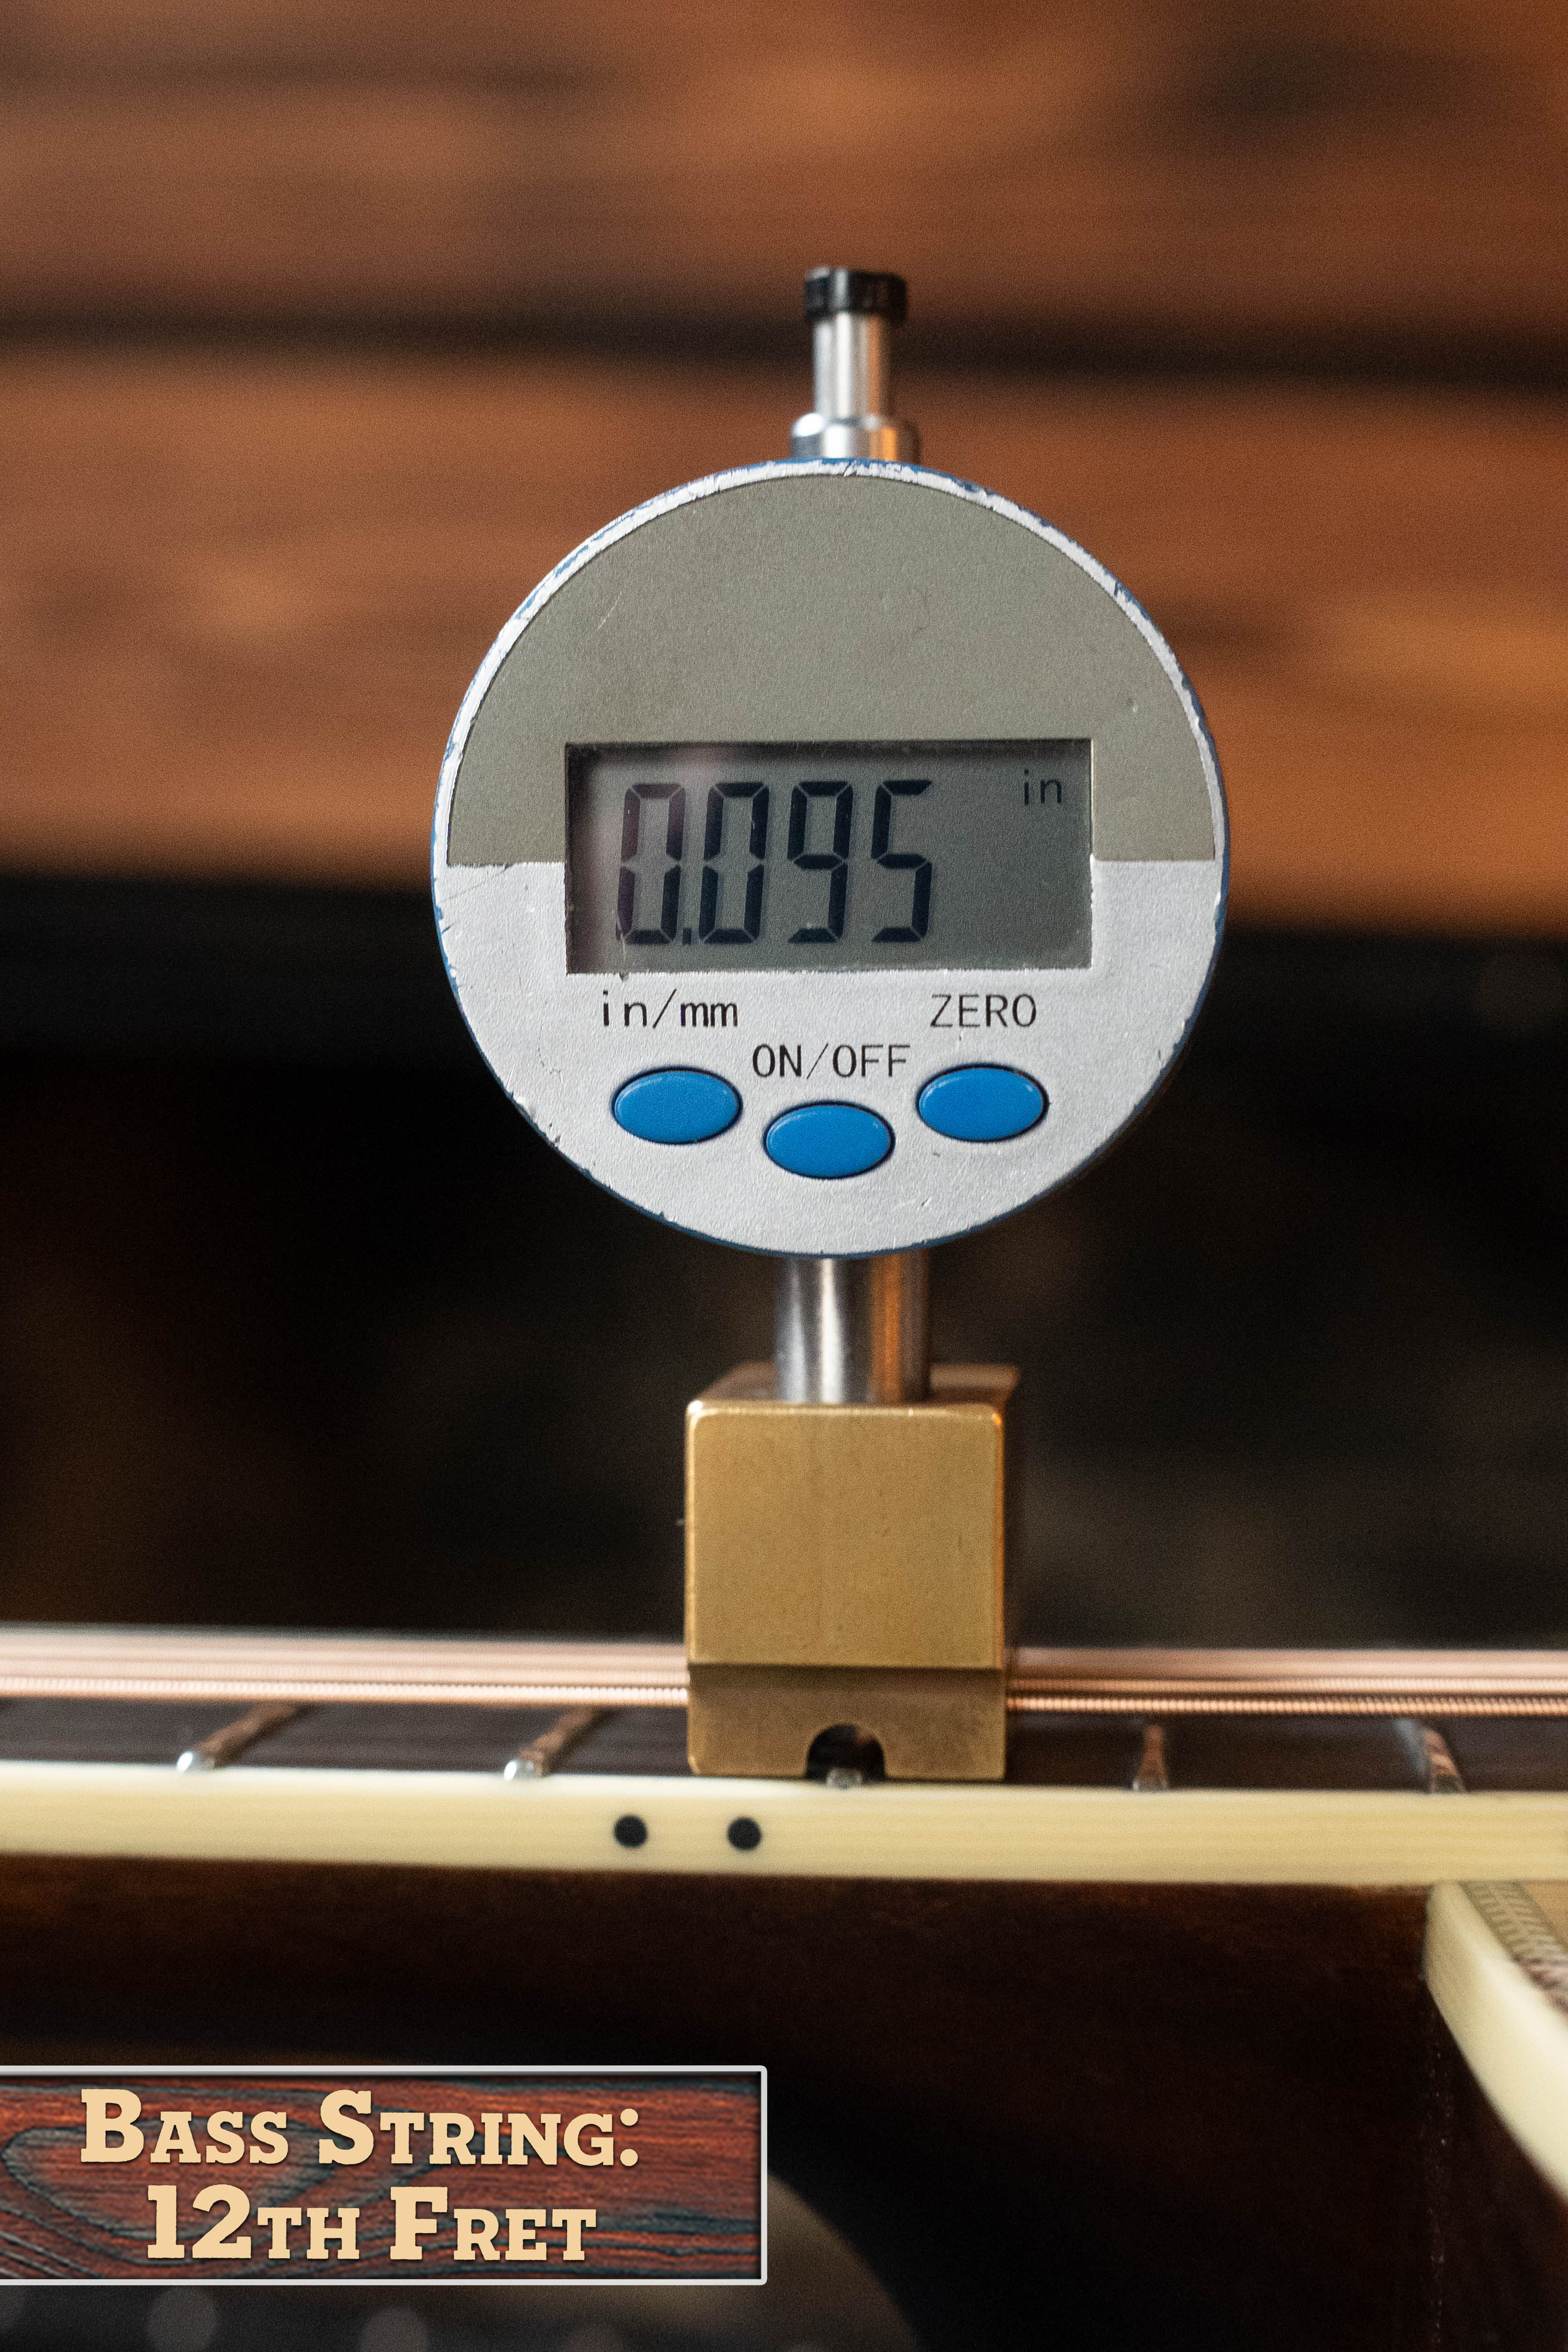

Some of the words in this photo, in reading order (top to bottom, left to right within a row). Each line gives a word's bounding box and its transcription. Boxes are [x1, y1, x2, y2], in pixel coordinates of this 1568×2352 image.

[617, 779, 933, 945] 0.095
[1023, 769, 1063, 806] in
[602, 988, 738, 1029] in/mm
[929, 993, 1037, 1028] ZERO
[752, 1043, 911, 1080] ON/OFF
